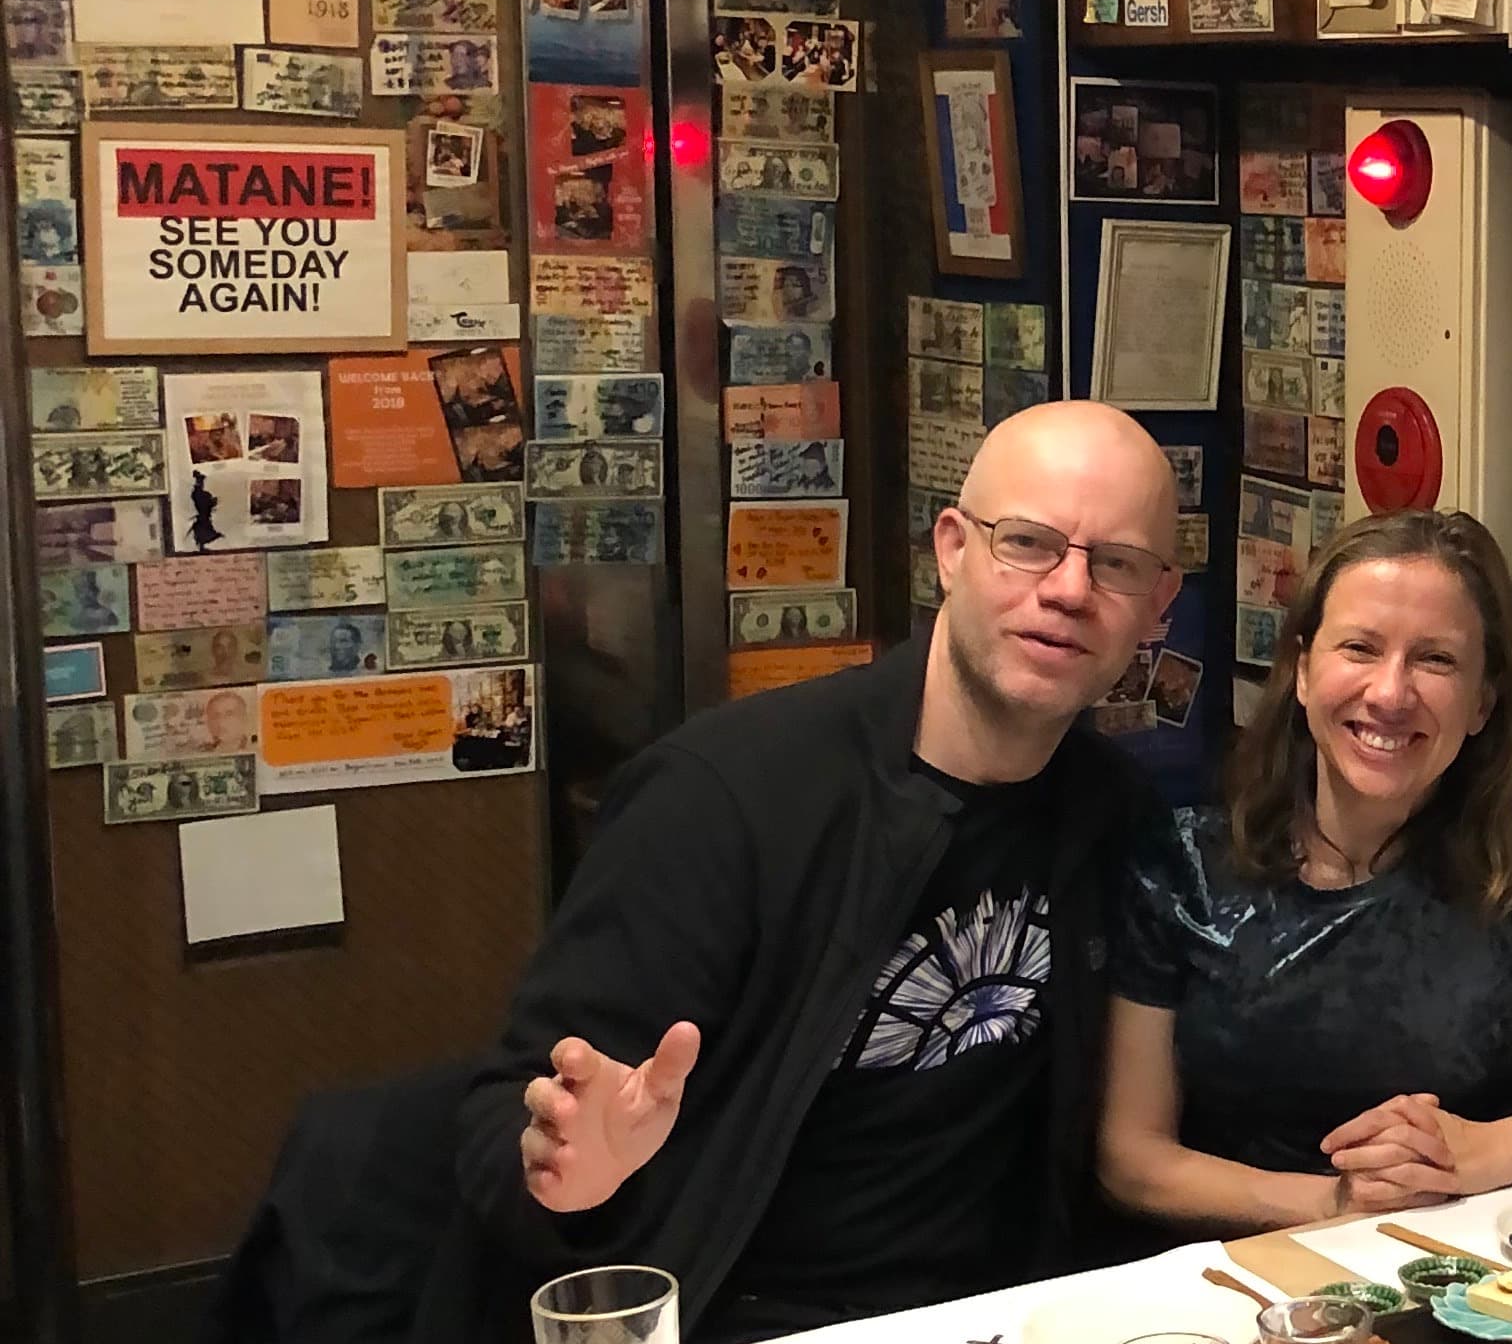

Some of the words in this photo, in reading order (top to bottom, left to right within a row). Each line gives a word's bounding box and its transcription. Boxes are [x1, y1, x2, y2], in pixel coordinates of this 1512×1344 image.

[1127, 0, 1167, 23] Gersh
[119, 161, 371, 207] MATANE!
[160, 216, 240, 245] SEE
[252, 217, 337, 246] YOU
[149, 249, 349, 279] SOMEDAY
[178, 283, 320, 313] AGAIN!
[338, 372, 398, 384] WELCOME
